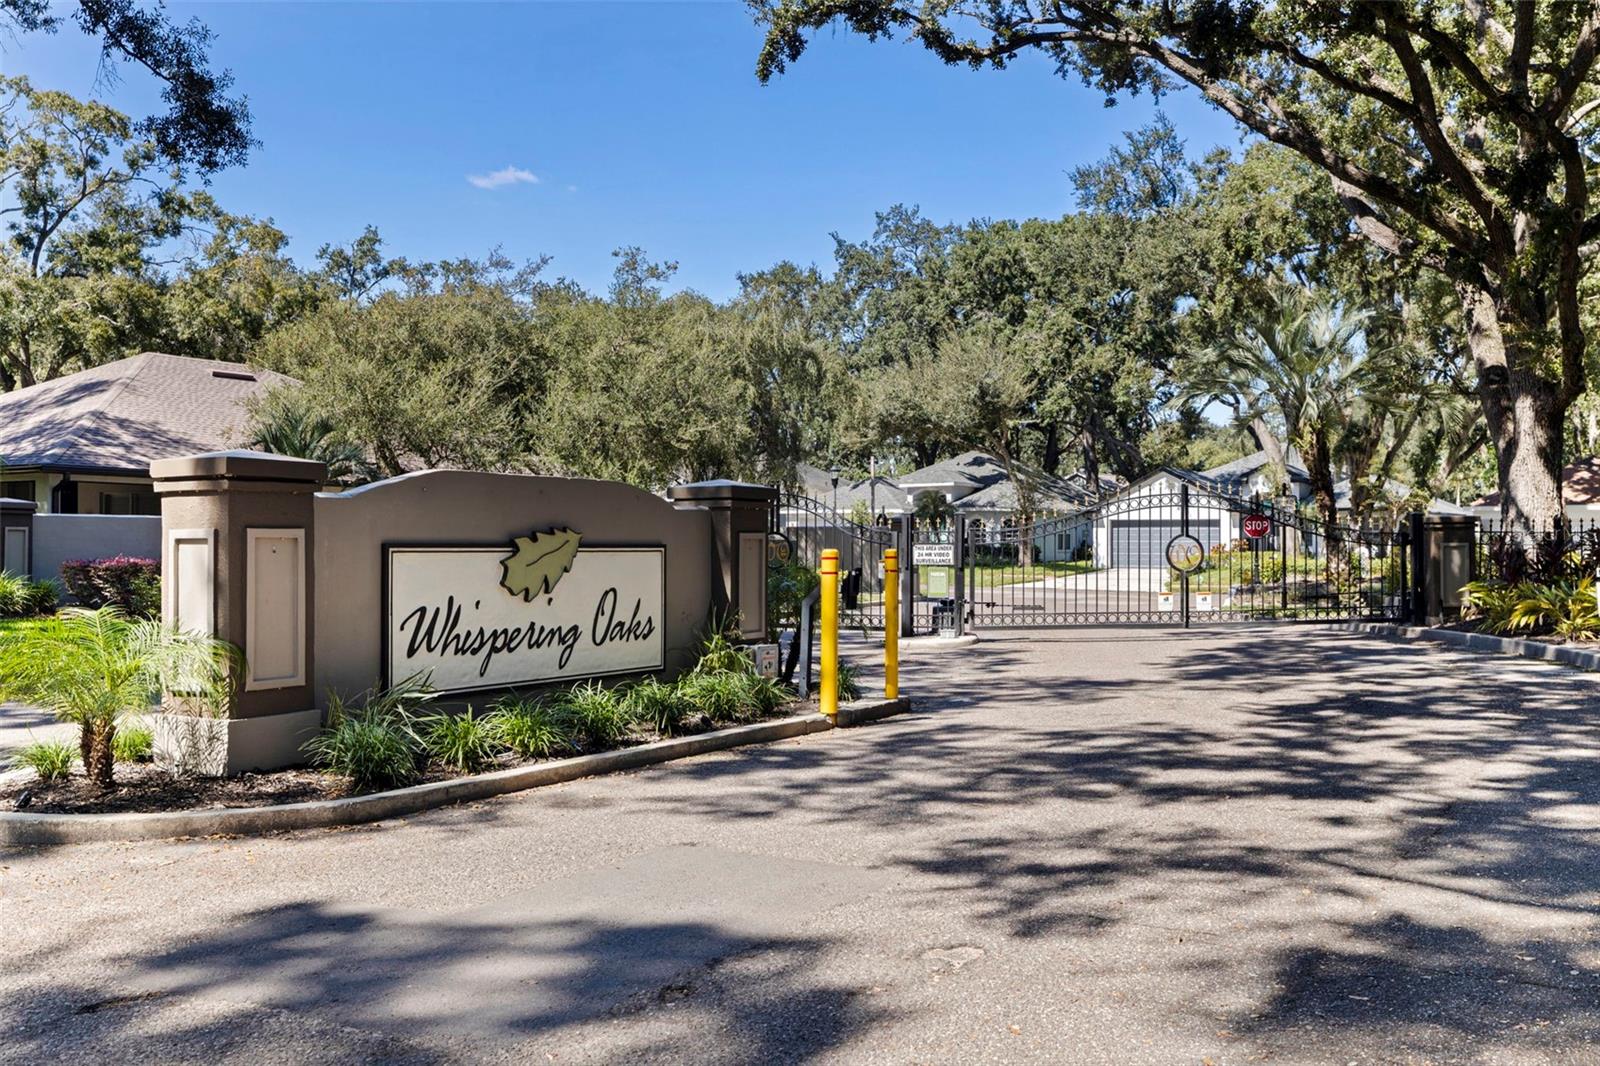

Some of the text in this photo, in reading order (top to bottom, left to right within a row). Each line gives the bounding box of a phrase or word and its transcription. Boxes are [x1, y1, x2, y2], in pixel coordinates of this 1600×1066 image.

[1245, 520, 1268, 531] STOP
[400, 587, 655, 677] Whispering Oaks
